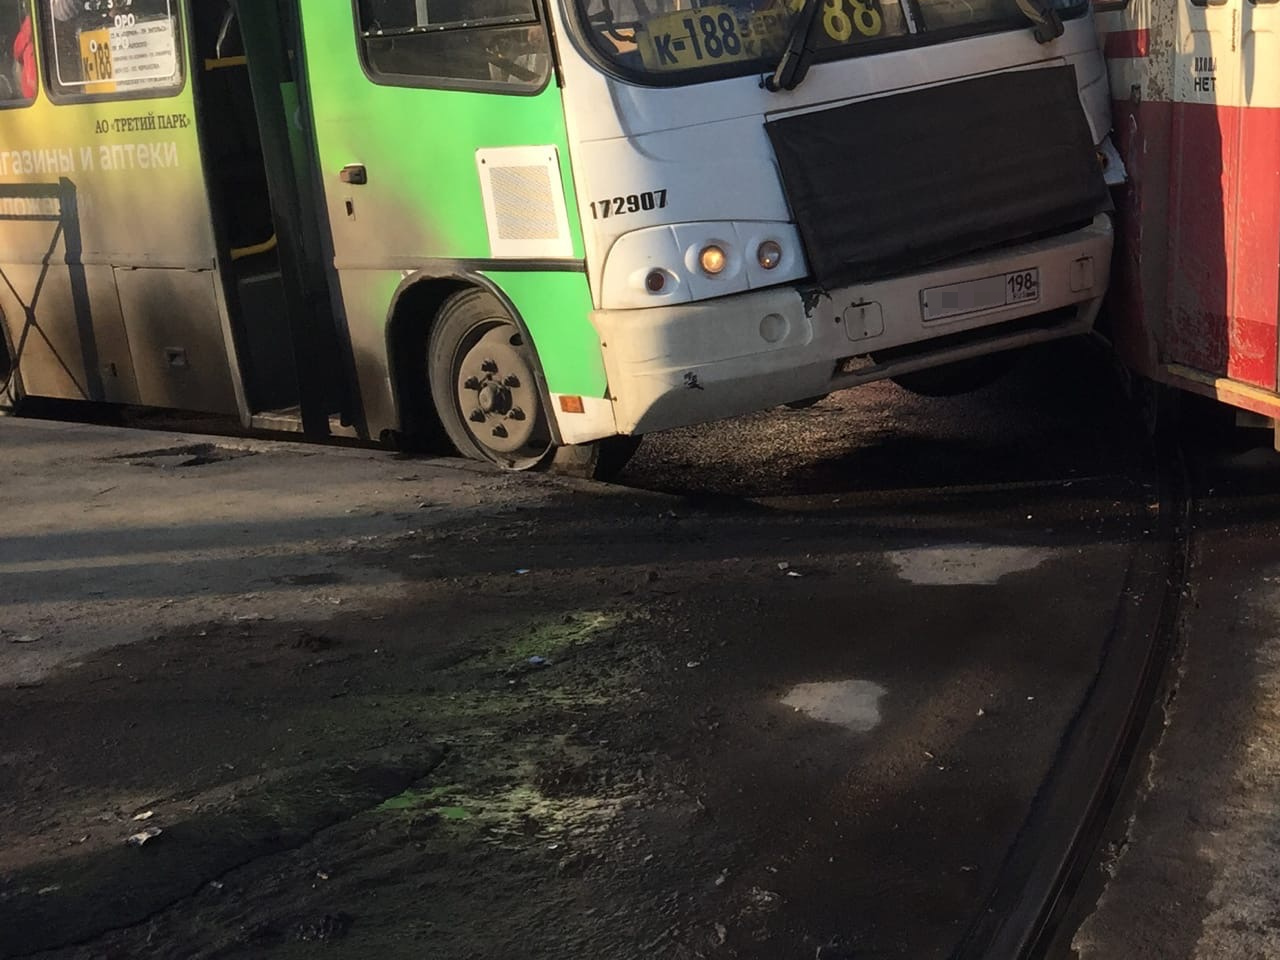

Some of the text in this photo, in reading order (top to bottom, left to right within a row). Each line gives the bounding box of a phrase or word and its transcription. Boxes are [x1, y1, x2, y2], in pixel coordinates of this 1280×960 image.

[1194, 77, 1216, 92] НЕТ
[95, 120, 109, 134] АО
[0, 141, 179, 175] газины и аптеки
[590, 189, 667, 219] 172907
[1008, 272, 1032, 293] 198
